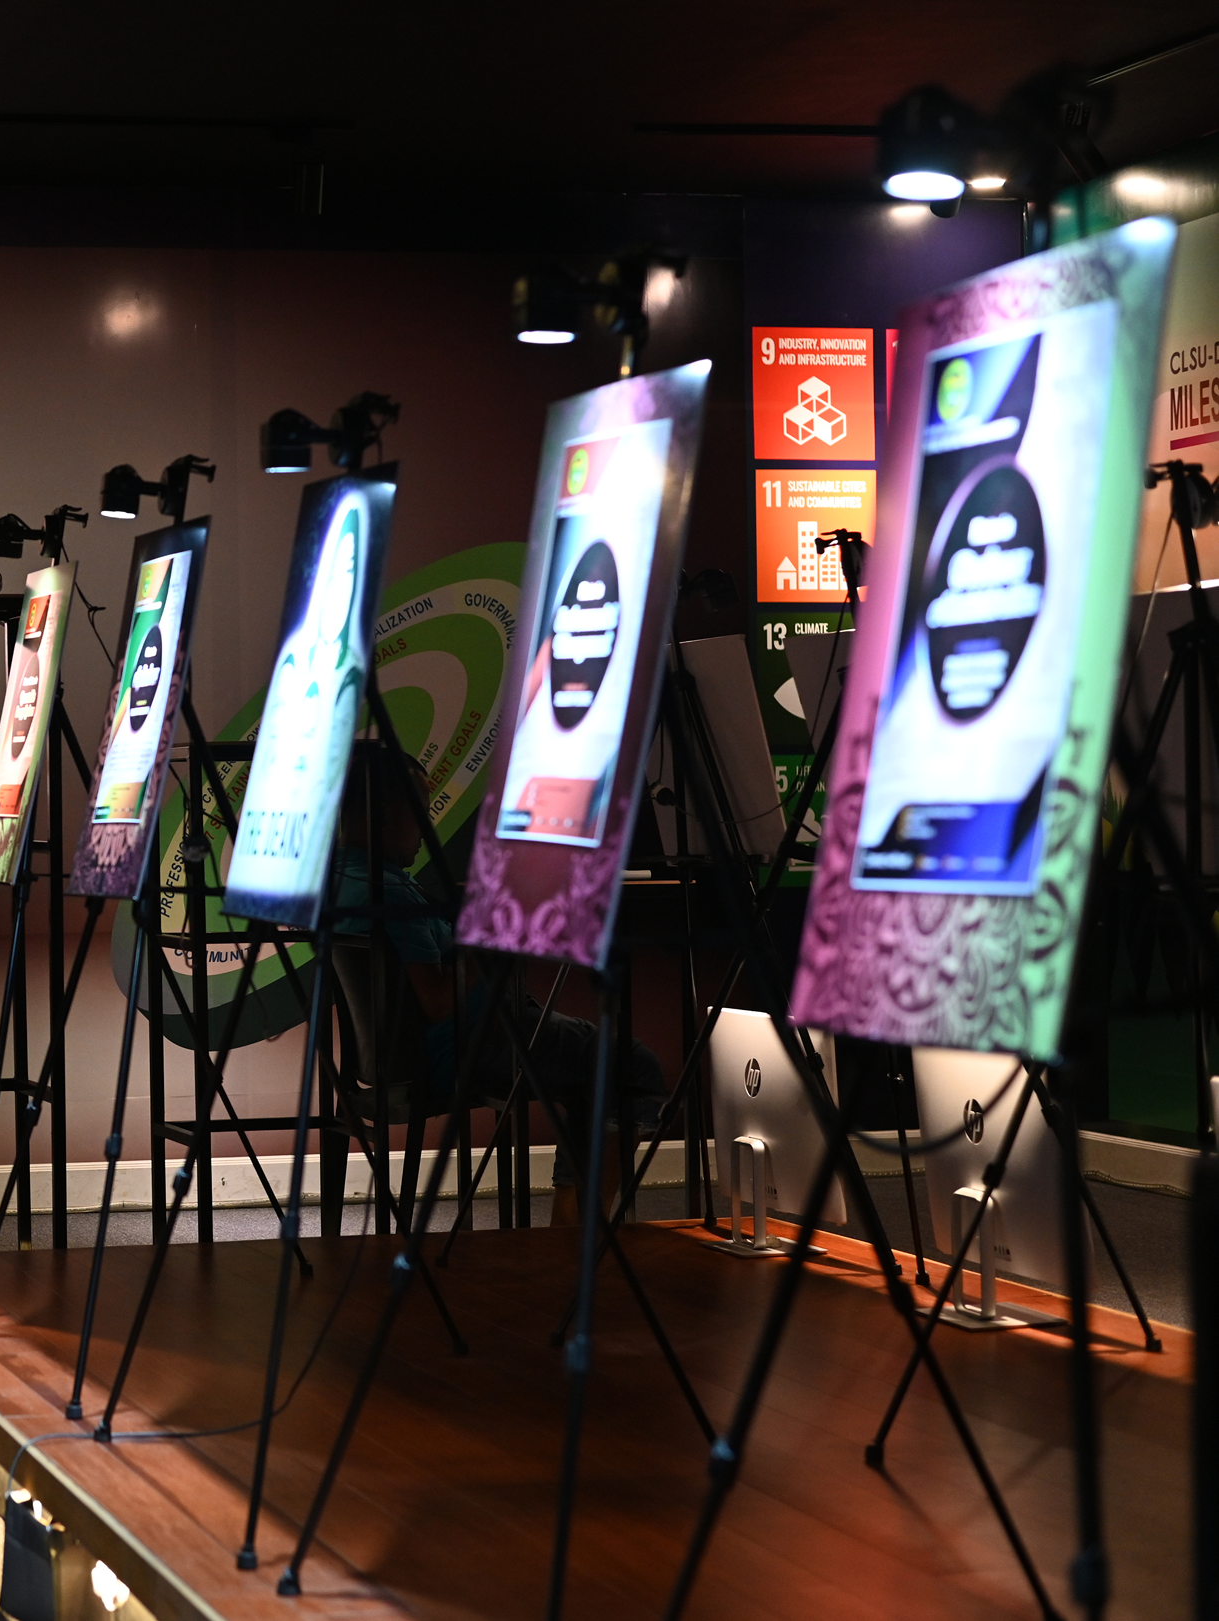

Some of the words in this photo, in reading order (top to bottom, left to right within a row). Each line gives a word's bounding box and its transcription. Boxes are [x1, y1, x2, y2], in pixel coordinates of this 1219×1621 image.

[761, 337, 776, 365] 9
[779, 338, 819, 351] INDUSTRY,
[820, 338, 867, 350] INNOVATION
[779, 353, 796, 365] AND
[797, 354, 867, 366] INFRASTRUCTURE
[762, 480, 782, 507] 11
[788, 480, 841, 492] SUSTAINABLE
[788, 496, 805, 508] AND
[763, 622, 788, 650] 13
[794, 622, 829, 635] CLIMATE
[373, 638, 407, 665] OALS
[450, 710, 482, 757] GOALS
[202, 760, 237, 804] CAEER
[775, 765, 789, 793] 5
[745, 1058, 762, 1098] hp
